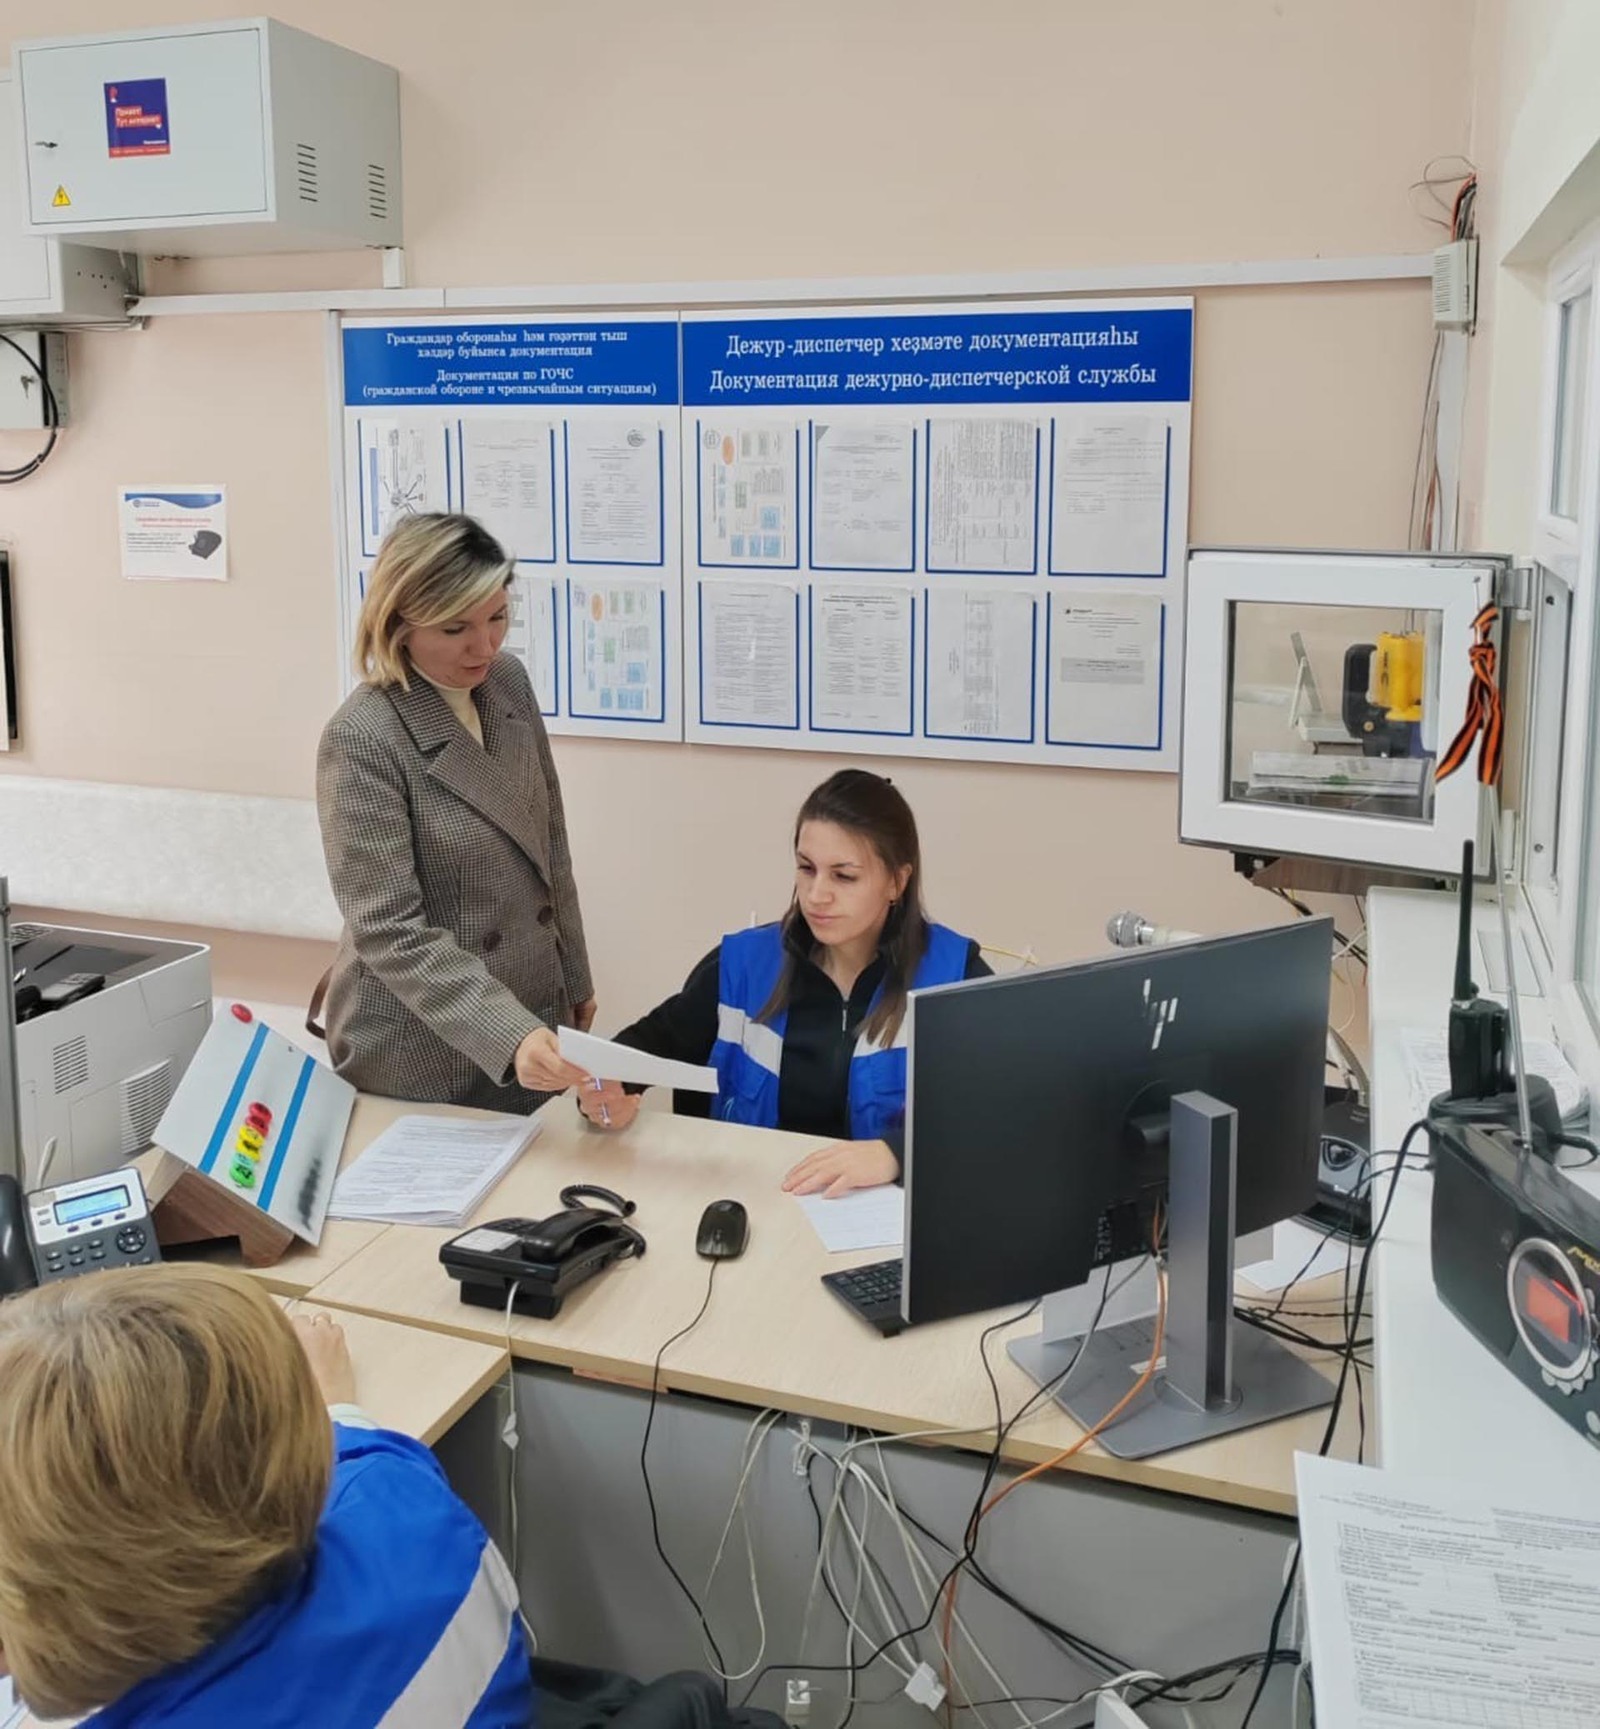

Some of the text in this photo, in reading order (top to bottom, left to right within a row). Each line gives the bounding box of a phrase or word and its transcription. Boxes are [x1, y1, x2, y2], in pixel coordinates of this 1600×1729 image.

[600, 331, 628, 341] тыш
[510, 347, 593, 358] документация
[726, 334, 885, 359] Дежур-диспетчер
[436, 367, 575, 382] Документация по ГОЧС
[709, 363, 1156, 393] Документация дежурно-диспетчерской службы
[363, 383, 657, 398] (гражданской обороне и чрезвычайным ситуациям)
